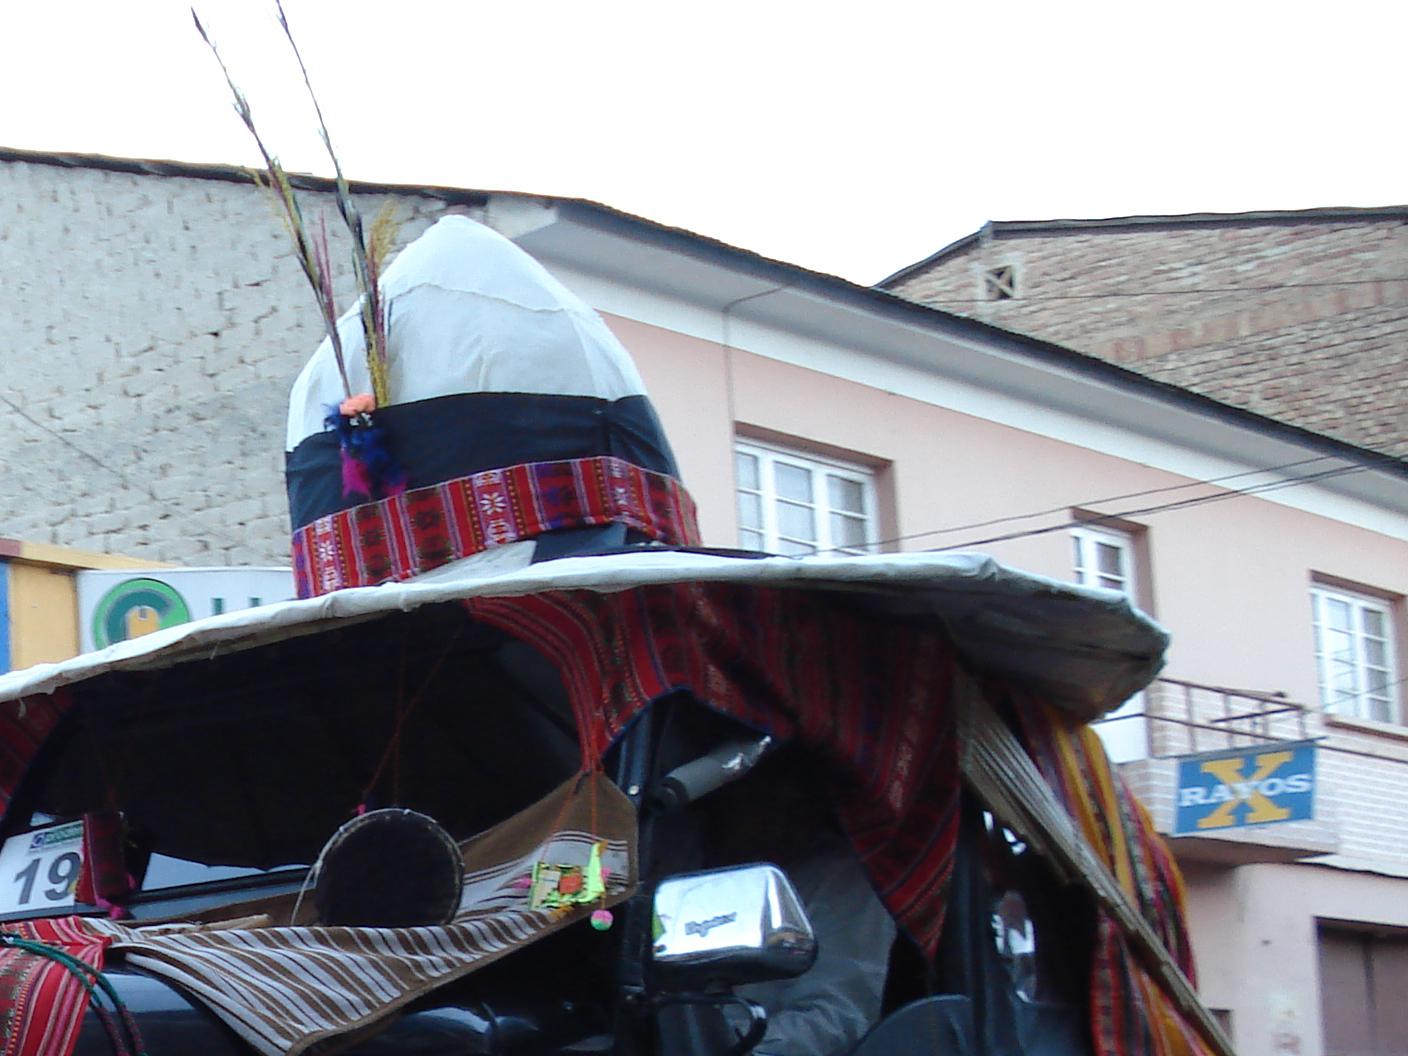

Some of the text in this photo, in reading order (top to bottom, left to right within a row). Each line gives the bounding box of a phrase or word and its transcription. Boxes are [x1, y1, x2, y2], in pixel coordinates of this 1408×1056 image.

[1178, 773, 1313, 807] RAYOS
[1197, 750, 1293, 829] X
[13, 851, 82, 906] 19
